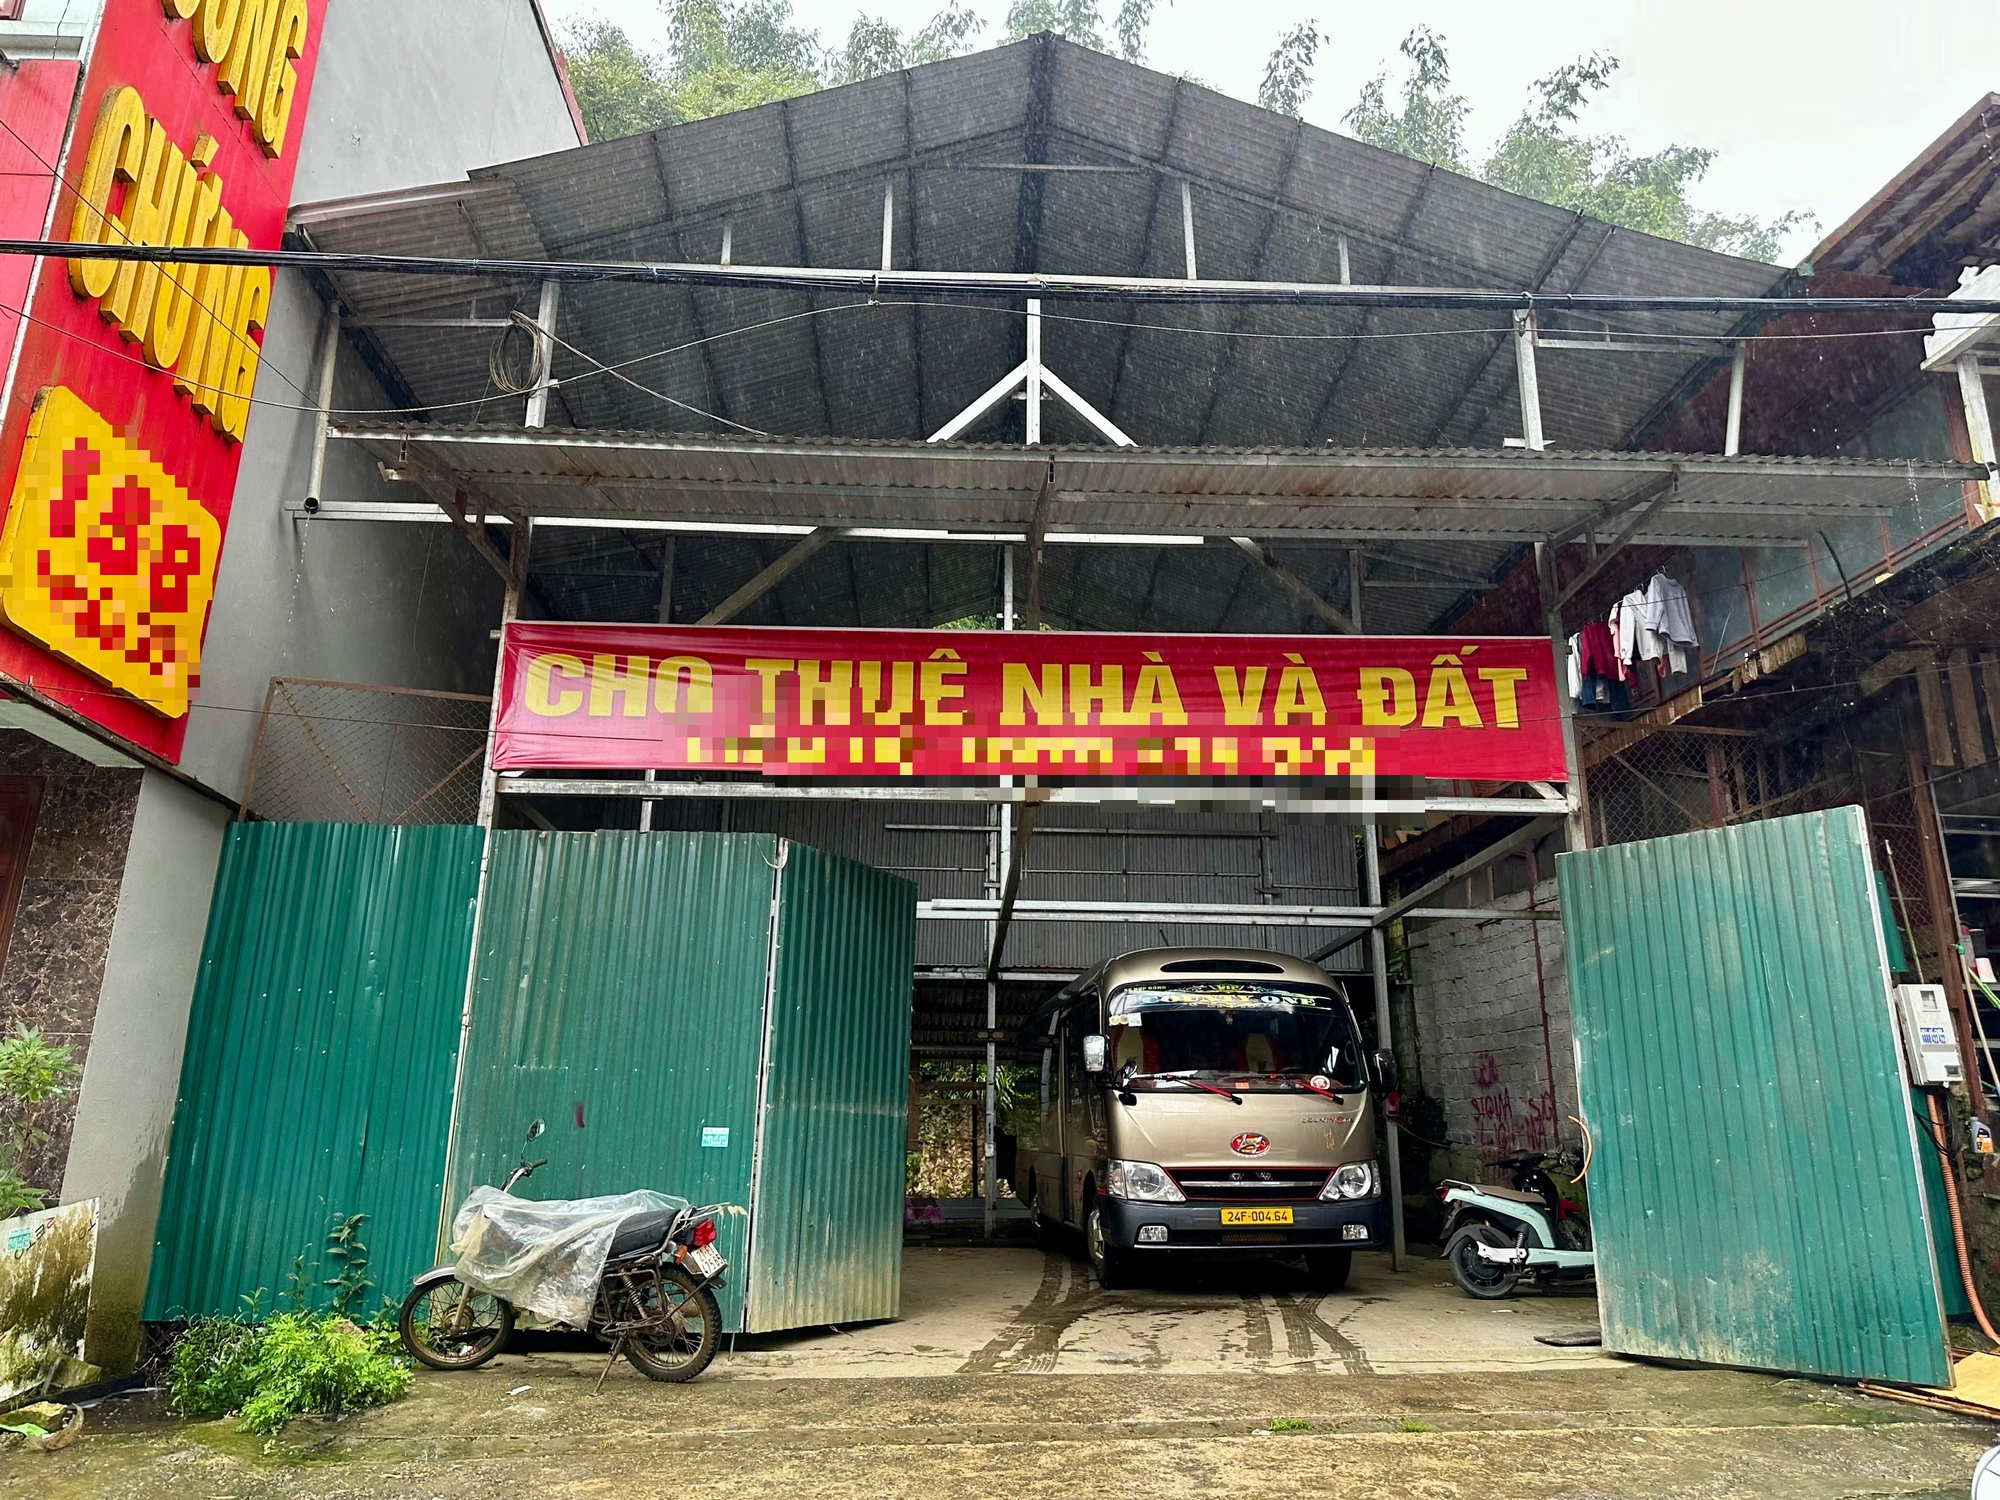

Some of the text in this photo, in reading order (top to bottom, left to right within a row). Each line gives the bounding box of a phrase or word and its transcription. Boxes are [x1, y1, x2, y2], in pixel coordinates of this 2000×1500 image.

[524, 645, 1528, 730] CHO THUÊ NHÀ VÀ ĐẤT
[1260, 995, 1316, 1006] ONE
